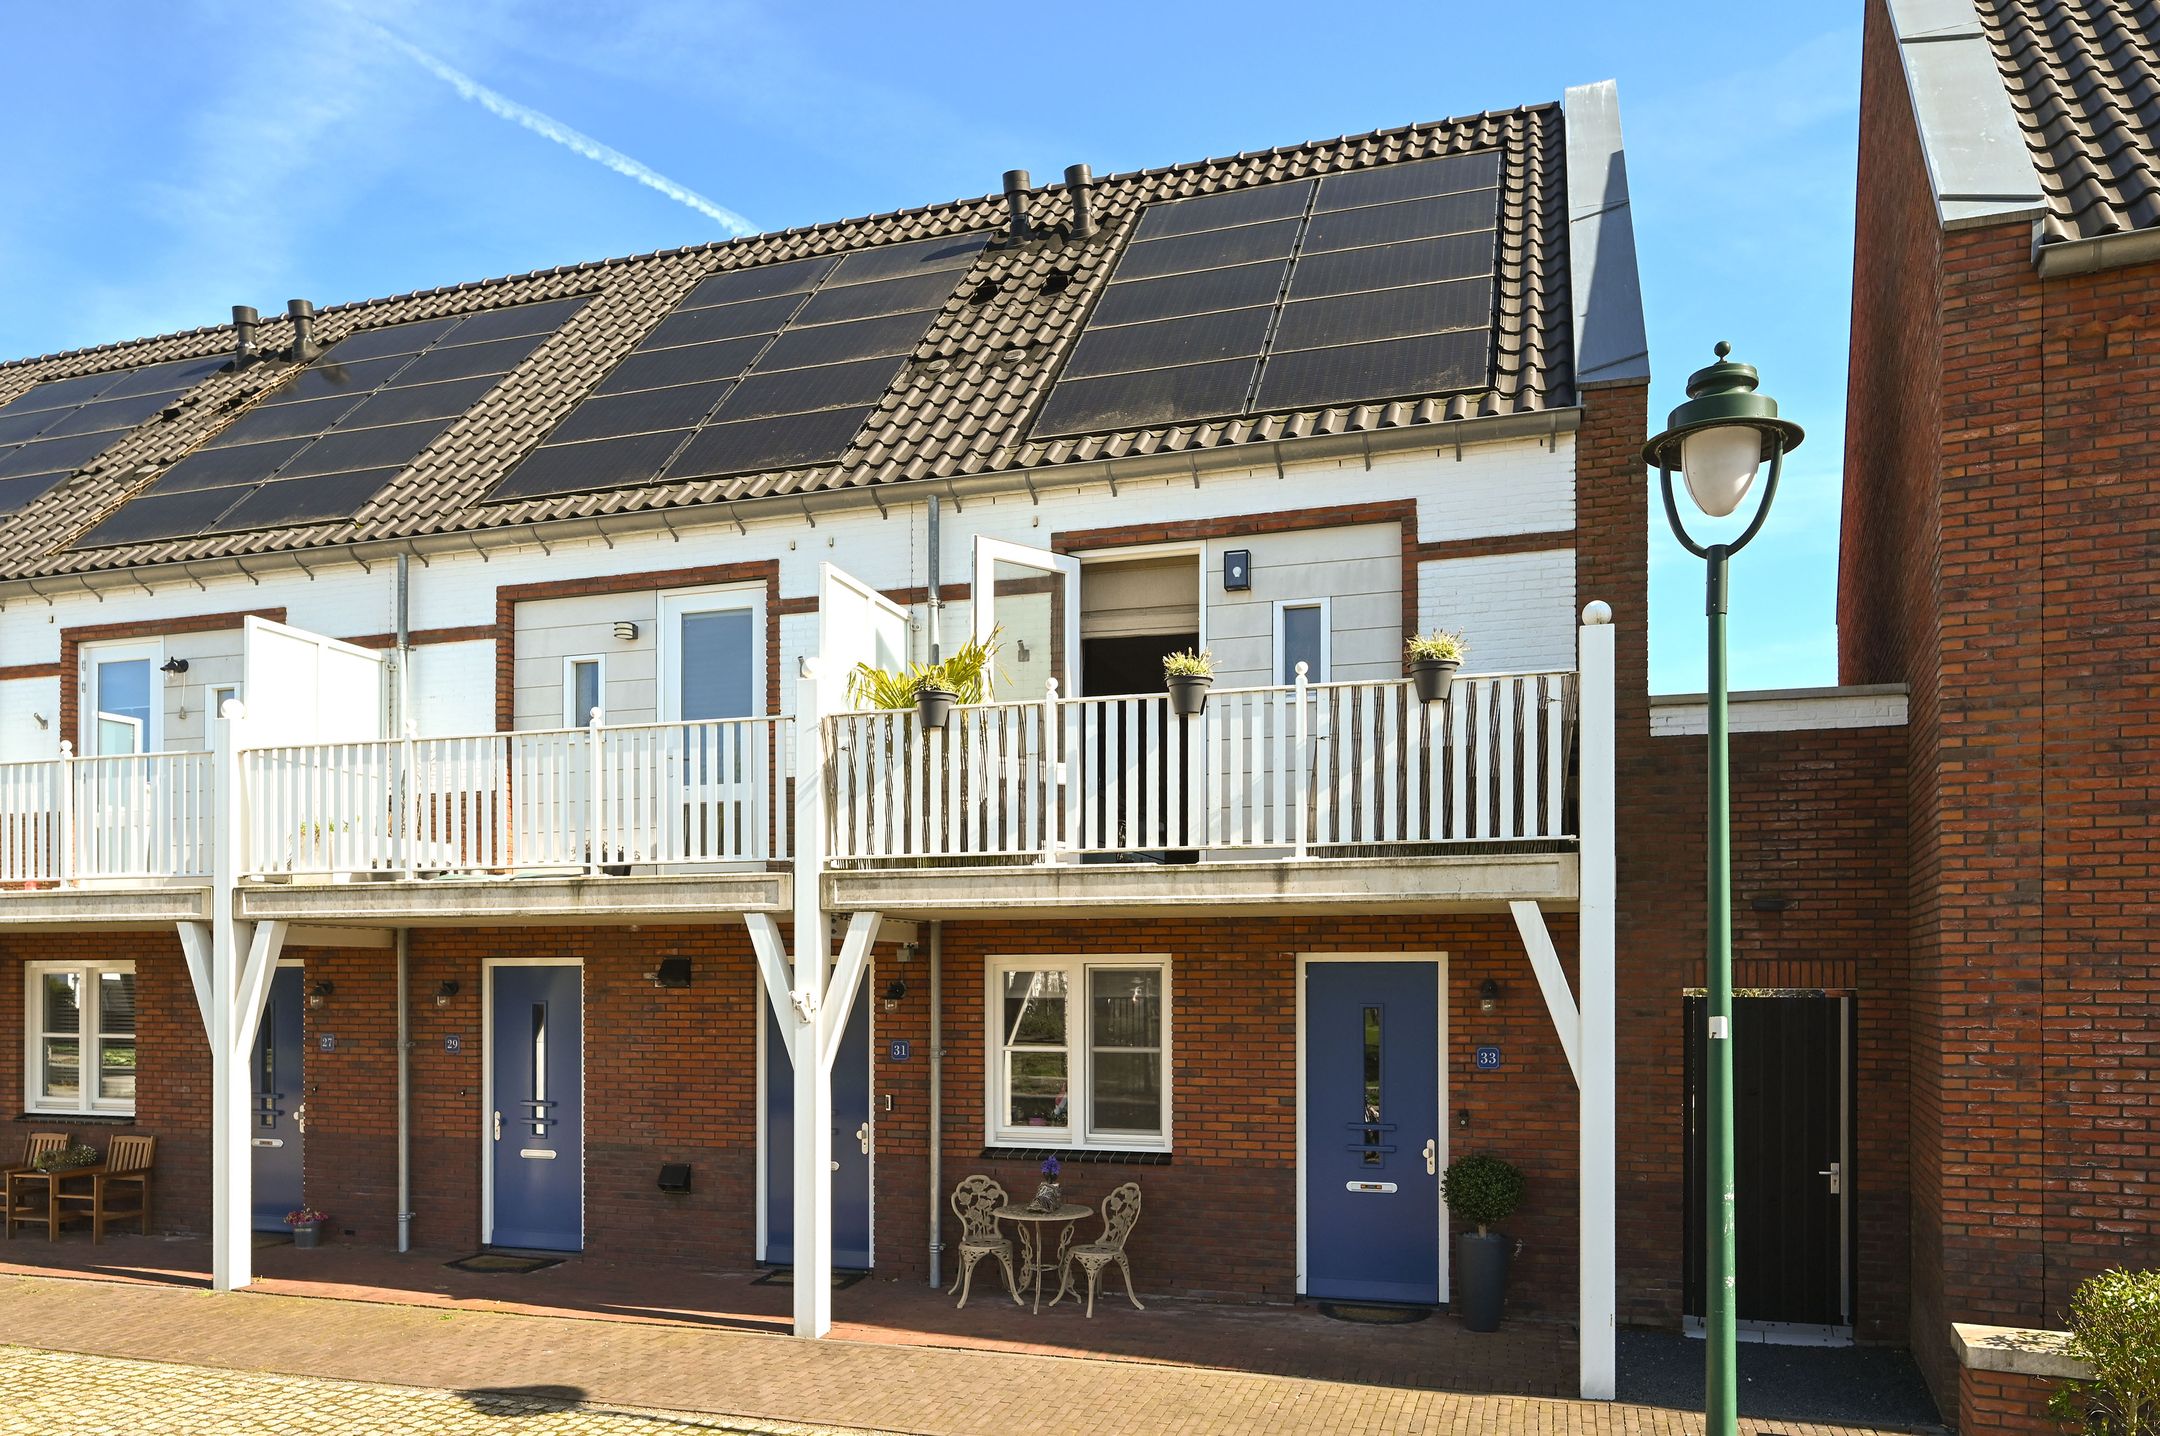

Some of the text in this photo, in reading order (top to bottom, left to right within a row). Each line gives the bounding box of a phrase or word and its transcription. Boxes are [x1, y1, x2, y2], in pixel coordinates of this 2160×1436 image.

[322, 1037, 333, 1048] 27
[447, 1039, 458, 1049] 29
[894, 1045, 906, 1056] 31
[1480, 1052, 1496, 1064] 33
